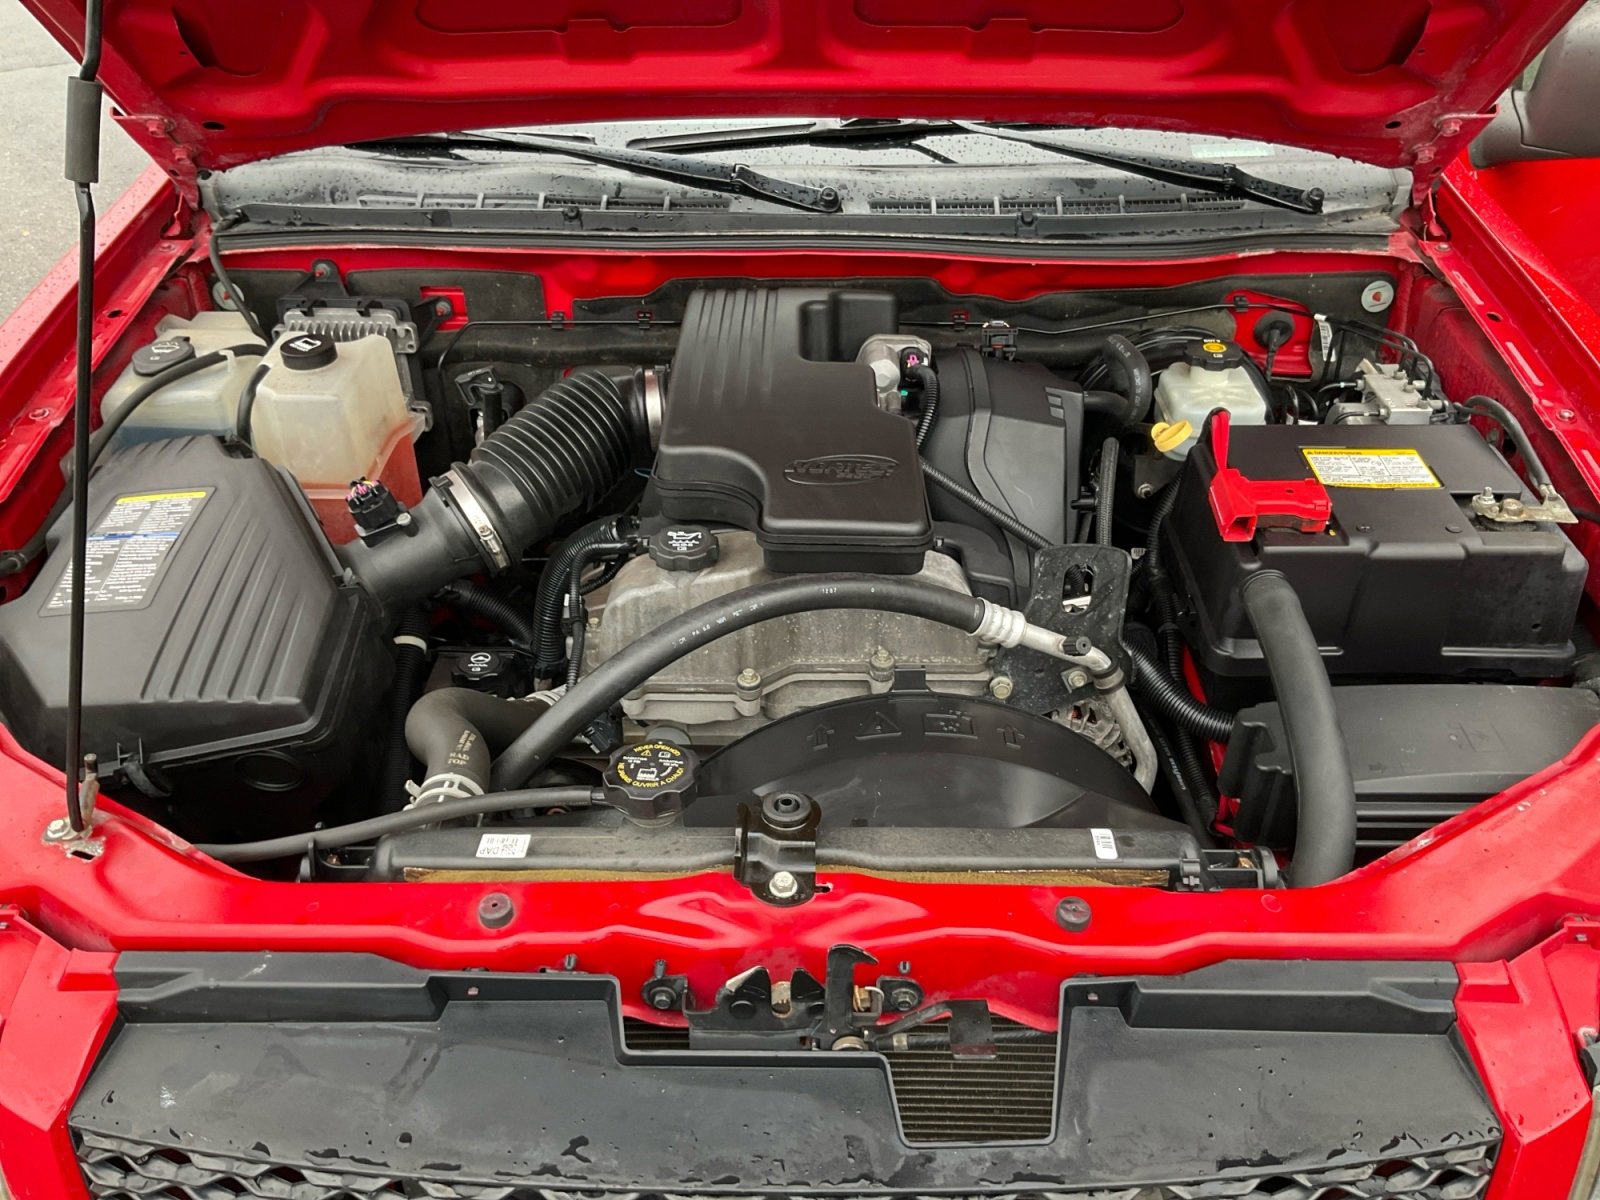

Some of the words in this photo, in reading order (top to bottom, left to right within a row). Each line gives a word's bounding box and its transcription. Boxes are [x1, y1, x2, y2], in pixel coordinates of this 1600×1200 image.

[633, 744, 653, 753] NEVER
[449, 752, 470, 761] RAD
[448, 758, 467, 766] TOP
[632, 780, 659, 788] OUVRIR
